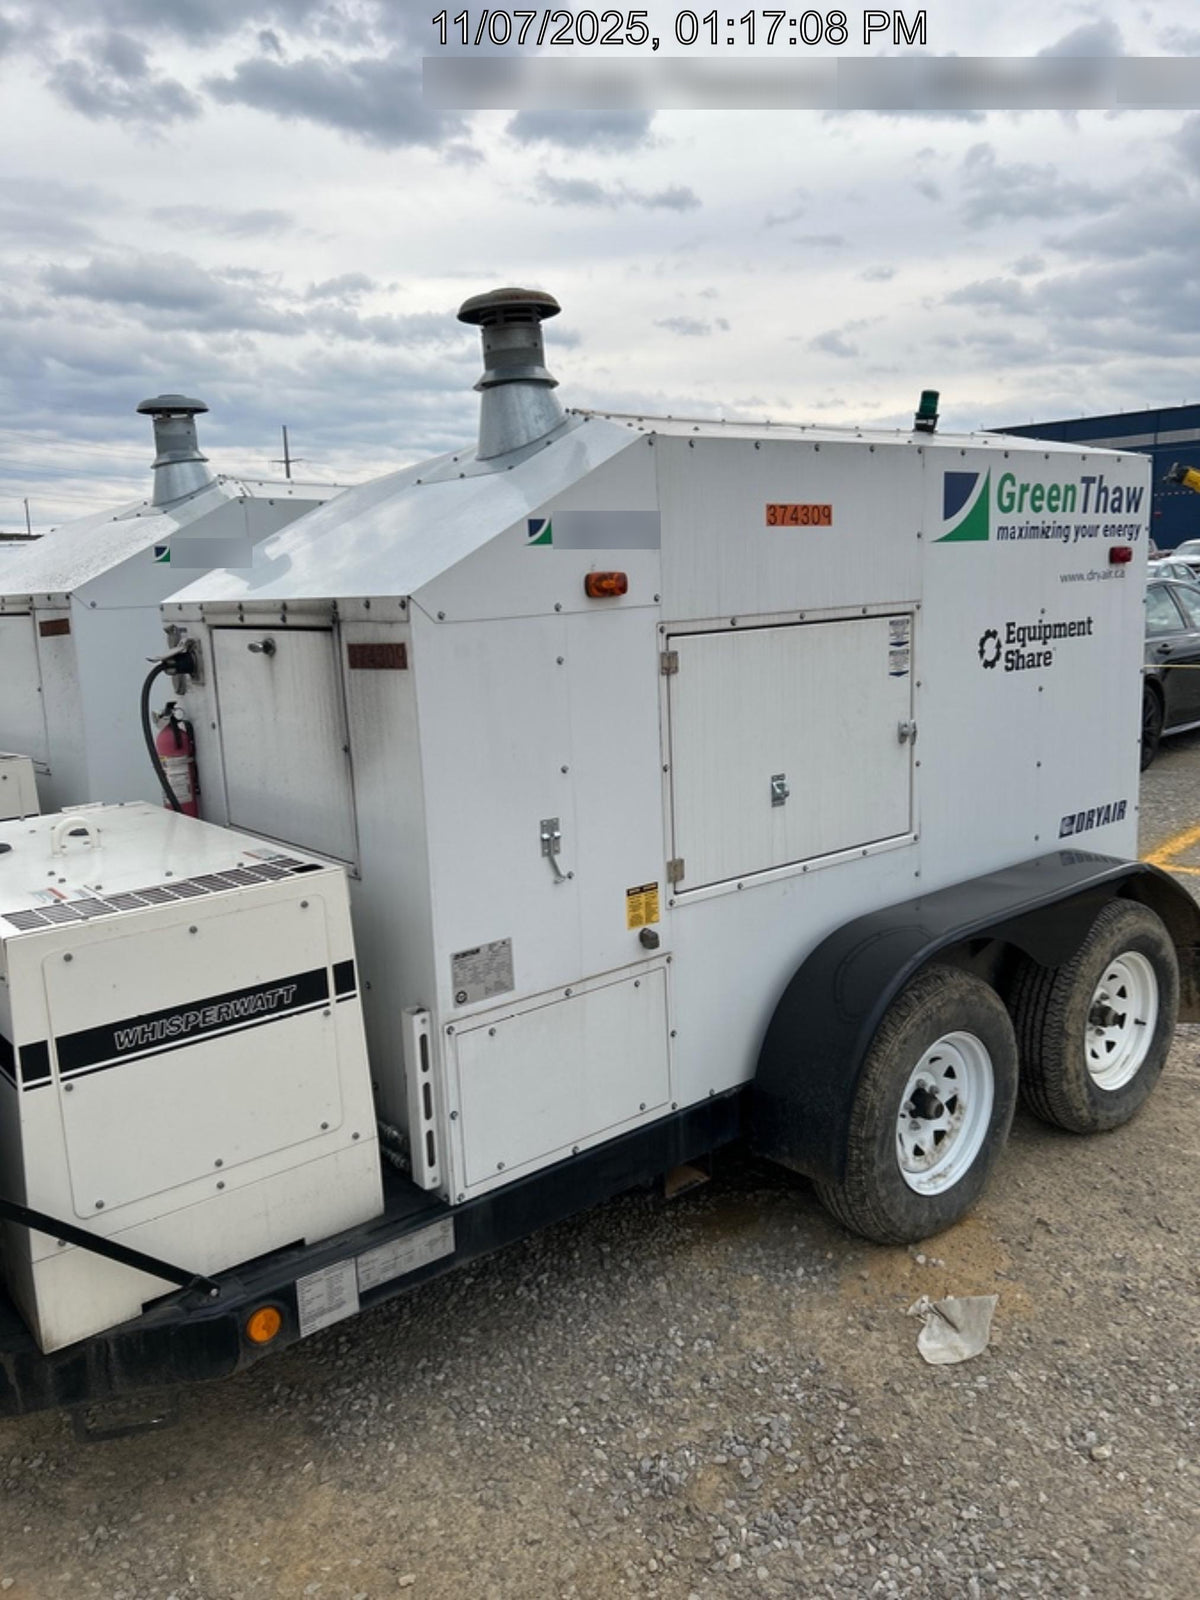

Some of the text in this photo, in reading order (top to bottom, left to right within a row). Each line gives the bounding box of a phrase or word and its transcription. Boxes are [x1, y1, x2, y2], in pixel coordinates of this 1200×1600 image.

[997, 472, 1144, 514] GreenThaw
[767, 504, 831, 526] 374309
[997, 520, 1142, 543] maximizing your energy
[1005, 616, 1093, 648] Equipment
[1004, 649, 1053, 672] Share
[1075, 799, 1127, 834] DRYAIR
[113, 984, 297, 1050] WHISPERWATT
